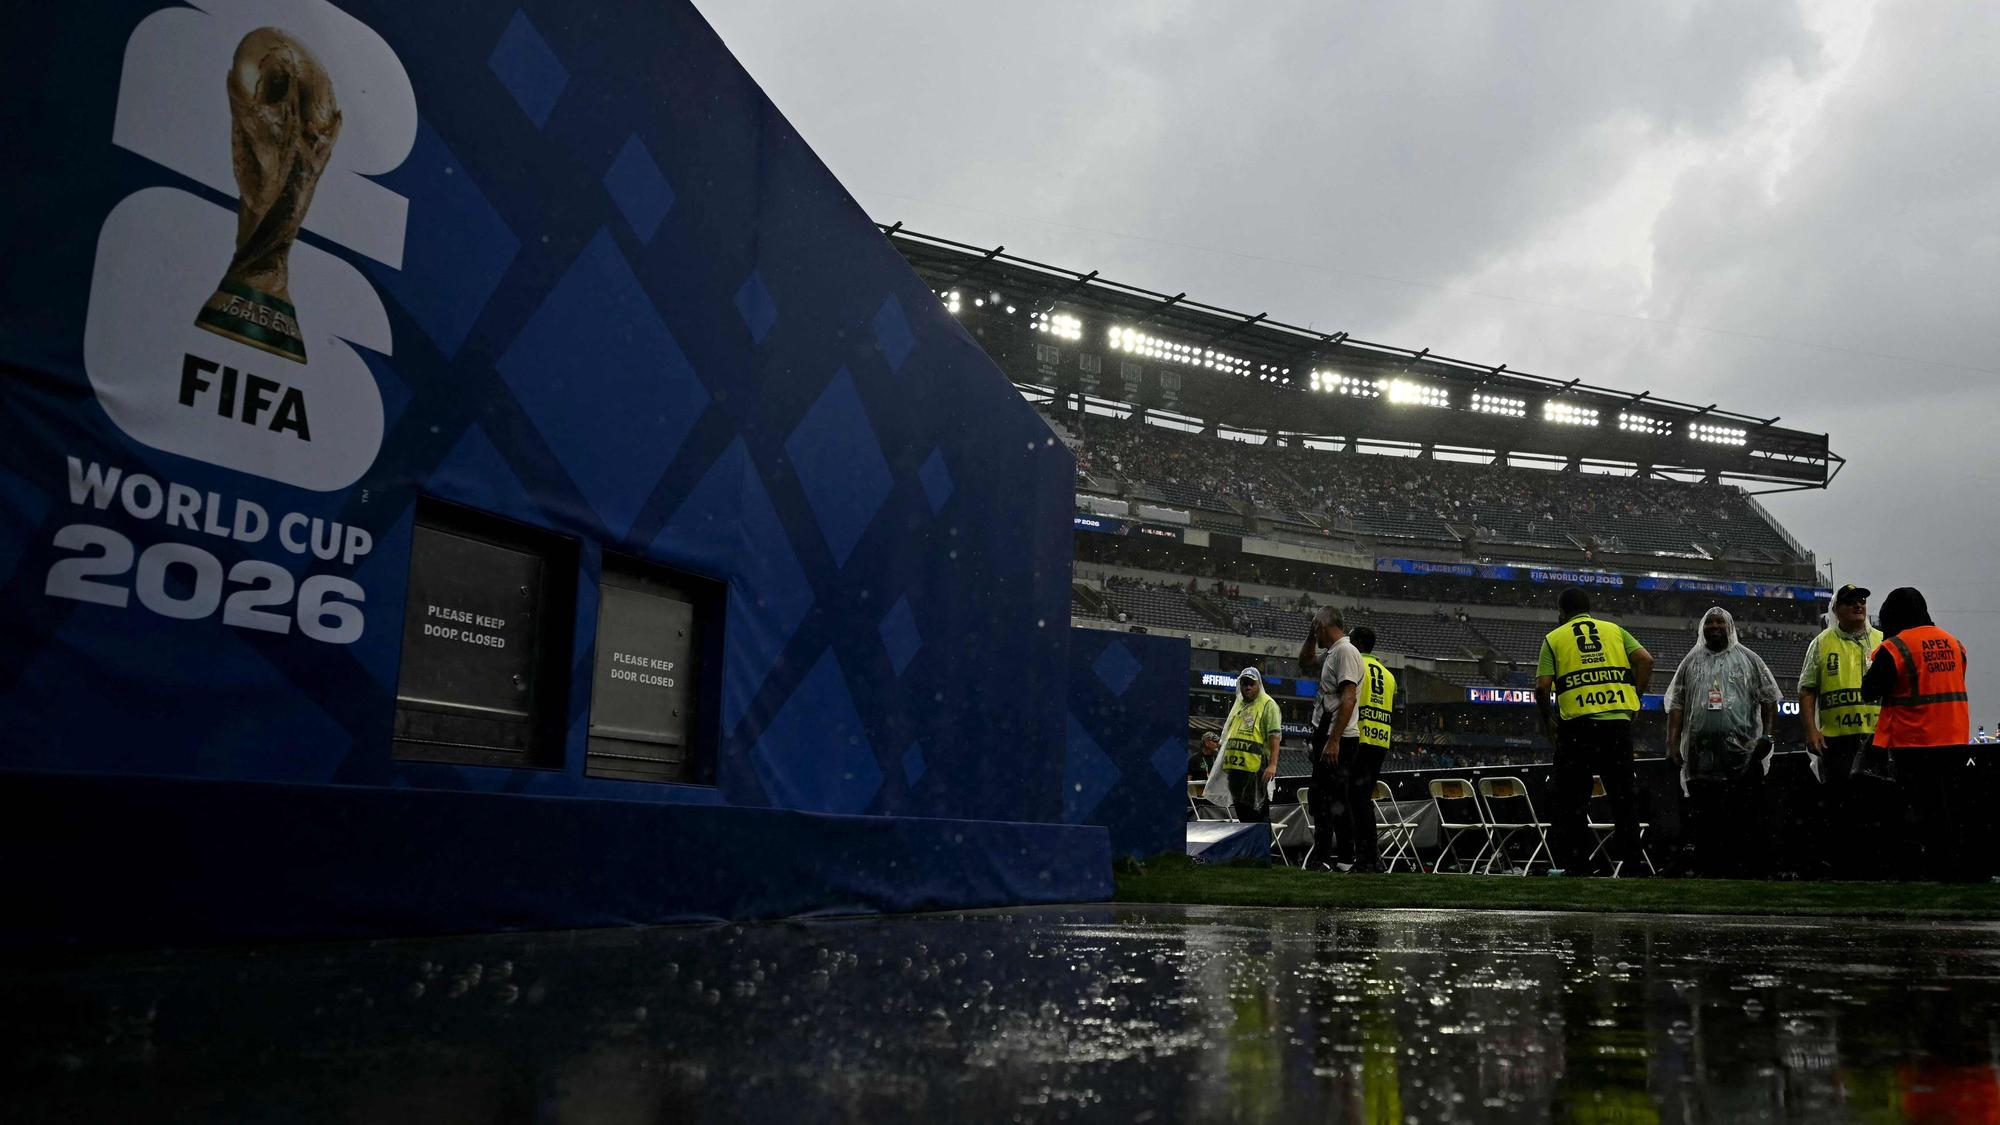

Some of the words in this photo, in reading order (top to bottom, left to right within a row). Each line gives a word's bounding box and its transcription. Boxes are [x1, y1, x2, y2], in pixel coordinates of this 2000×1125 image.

[178, 353, 312, 442] FIFA
[67, 456, 269, 544] WORLD
[279, 511, 373, 565] CUP
[45, 524, 365, 645] 2026
[1531, 571, 1549, 580] FIFA
[1549, 573, 1579, 582] WORLD
[1579, 575, 1596, 583] CUP
[1596, 576, 1624, 585] 2026
[427, 604, 474, 624] PLEASE
[475, 614, 506, 630] KEEP
[460, 631, 506, 649] CLOSED
[1921, 638, 1951, 650] APEX
[613, 651, 649, 668] PLEASE
[650, 658, 674, 672] KEEP
[1581, 656, 1605, 664] 2026
[1922, 649, 1955, 662] SECURITY
[1927, 660, 1956, 673] GROUP
[611, 668, 638, 682] DOOR
[639, 673, 675, 688] CLOSED
[1565, 669, 1626, 688] SECURITY
[1575, 690, 1625, 708] 14021
[1835, 712, 1879, 730] 1441
